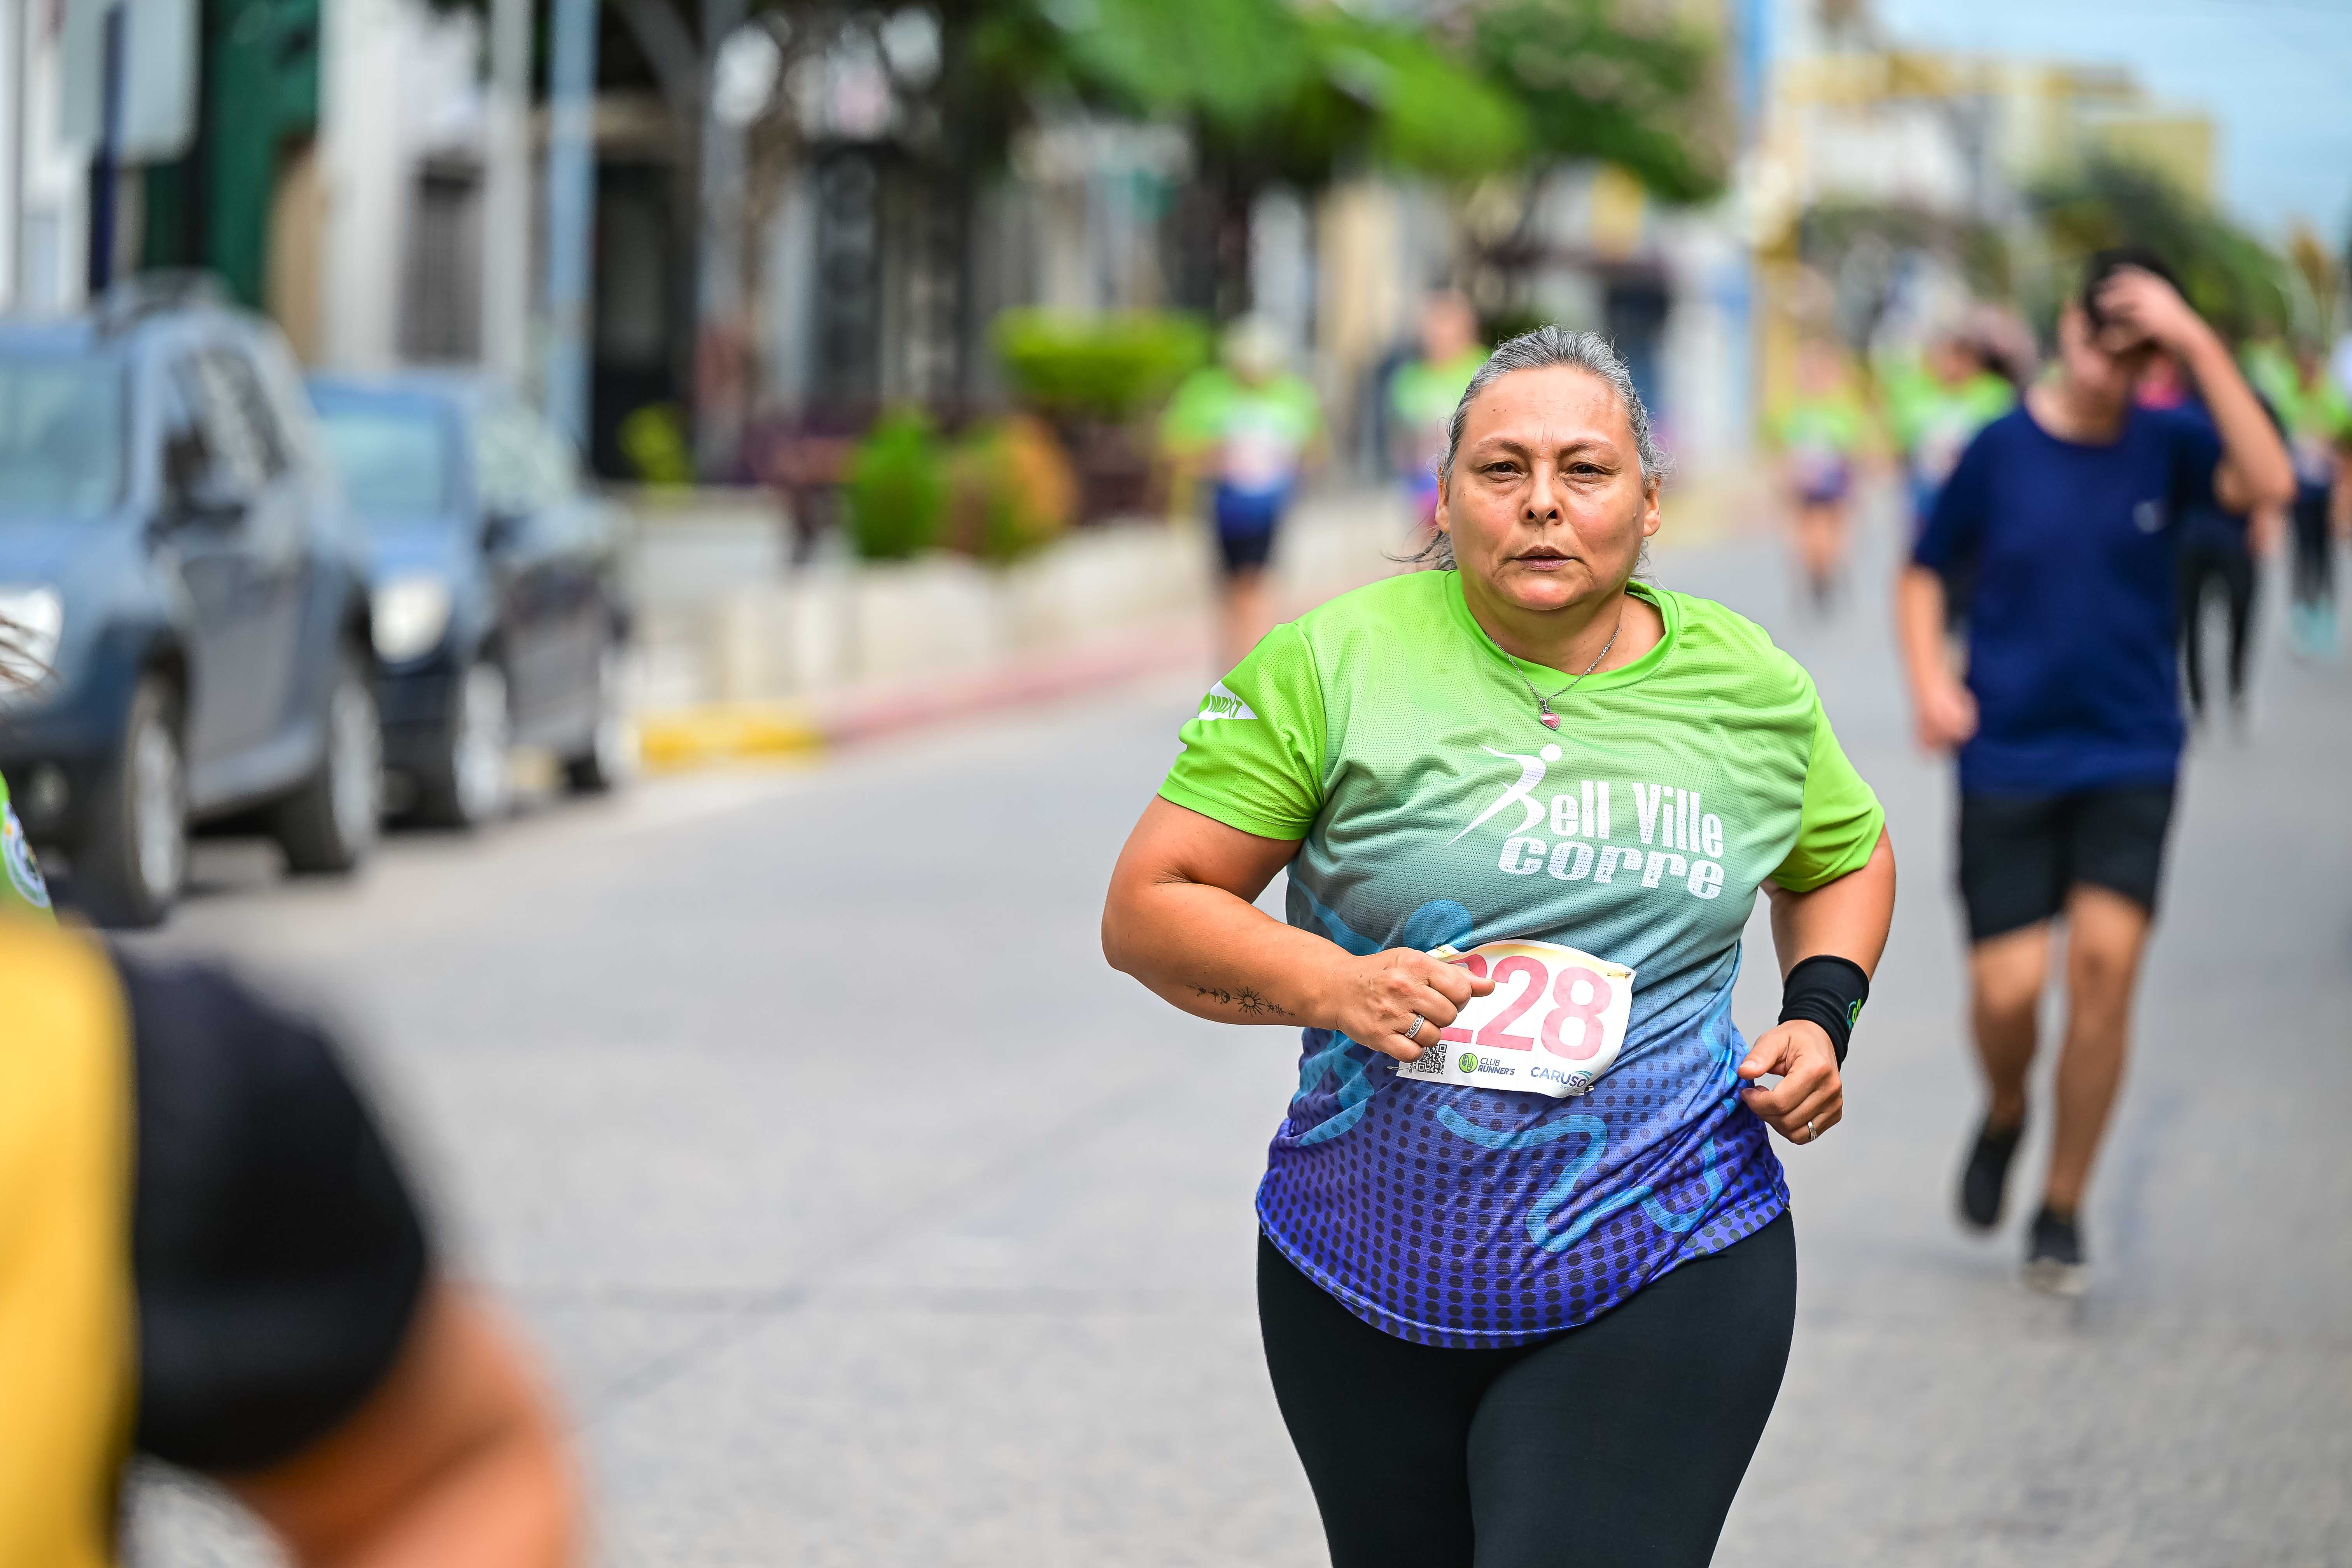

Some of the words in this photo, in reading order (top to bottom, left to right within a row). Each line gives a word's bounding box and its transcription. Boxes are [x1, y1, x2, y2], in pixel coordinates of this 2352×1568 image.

[1634, 782, 1724, 858] Ville
[1497, 837, 1725, 900] corre
[1478, 1065, 1516, 1075] RUNNER'S
[1480, 1058, 1500, 1066] CLUB
[1531, 1067, 1587, 1088] CARUSO
